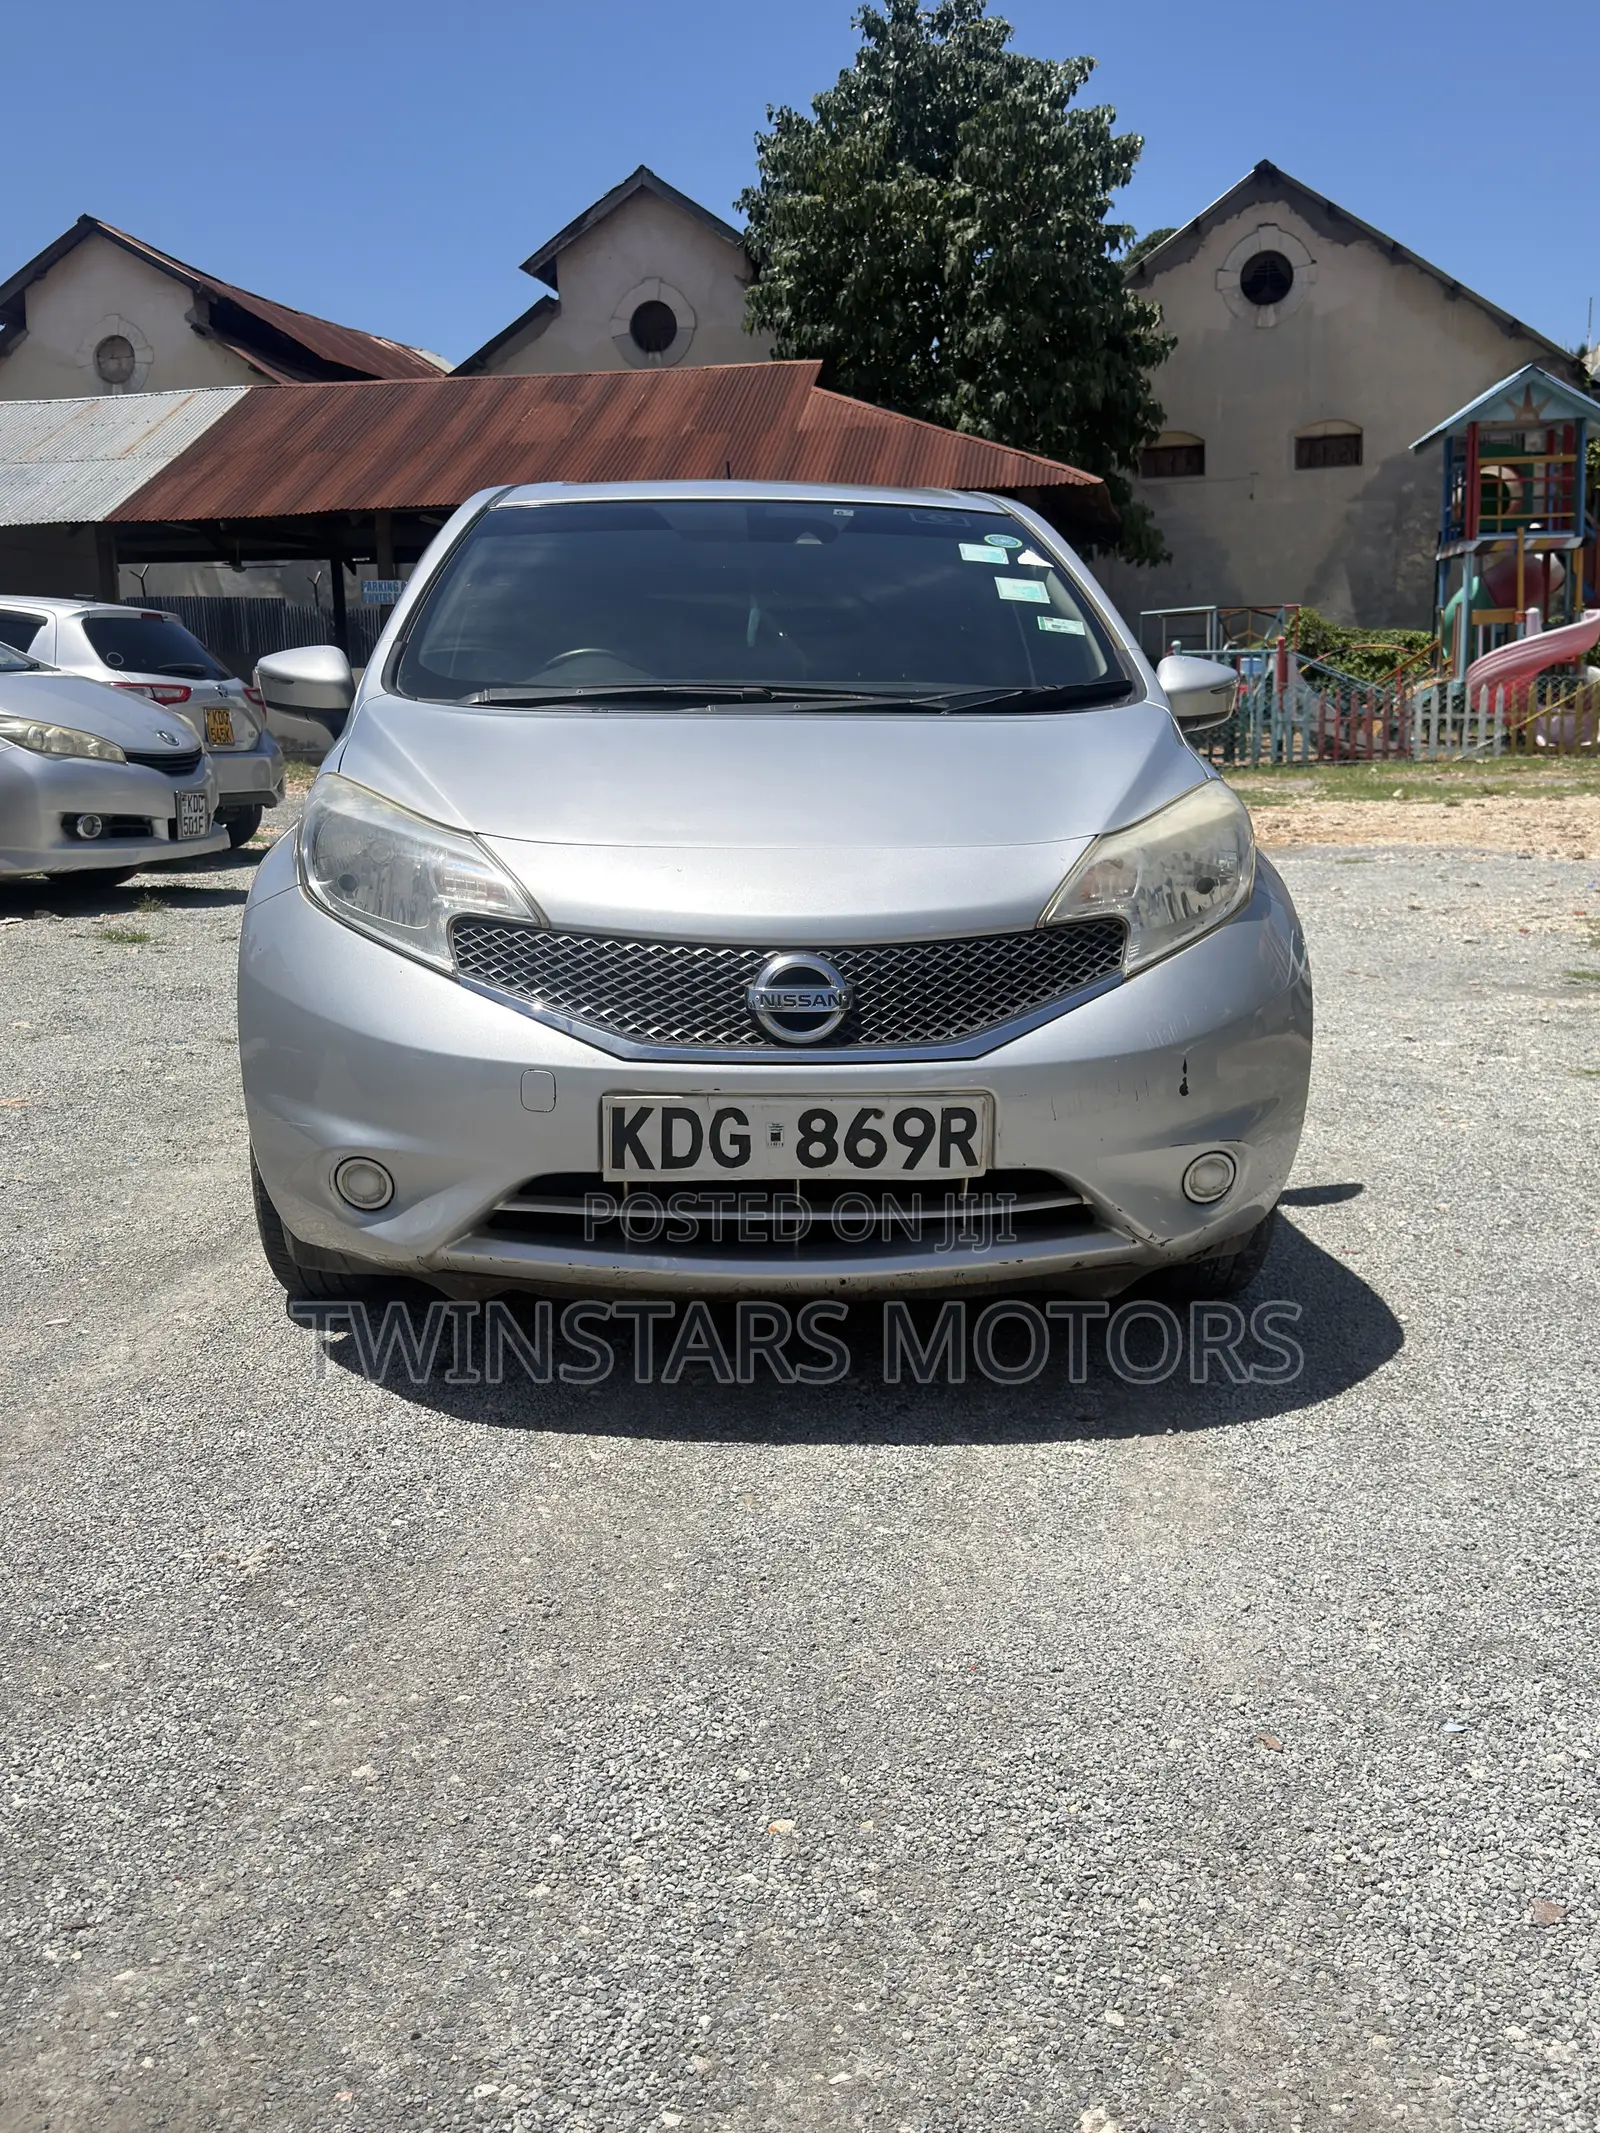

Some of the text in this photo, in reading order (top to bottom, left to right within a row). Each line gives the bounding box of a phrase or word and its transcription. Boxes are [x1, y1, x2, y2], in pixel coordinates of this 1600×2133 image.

[362, 581, 399, 592] PARKING
[210, 727, 232, 742] 545K
[183, 815, 204, 836] 501F
[760, 994, 842, 1007] NISSAN
[611, 1106, 979, 1170] KDG 869R
